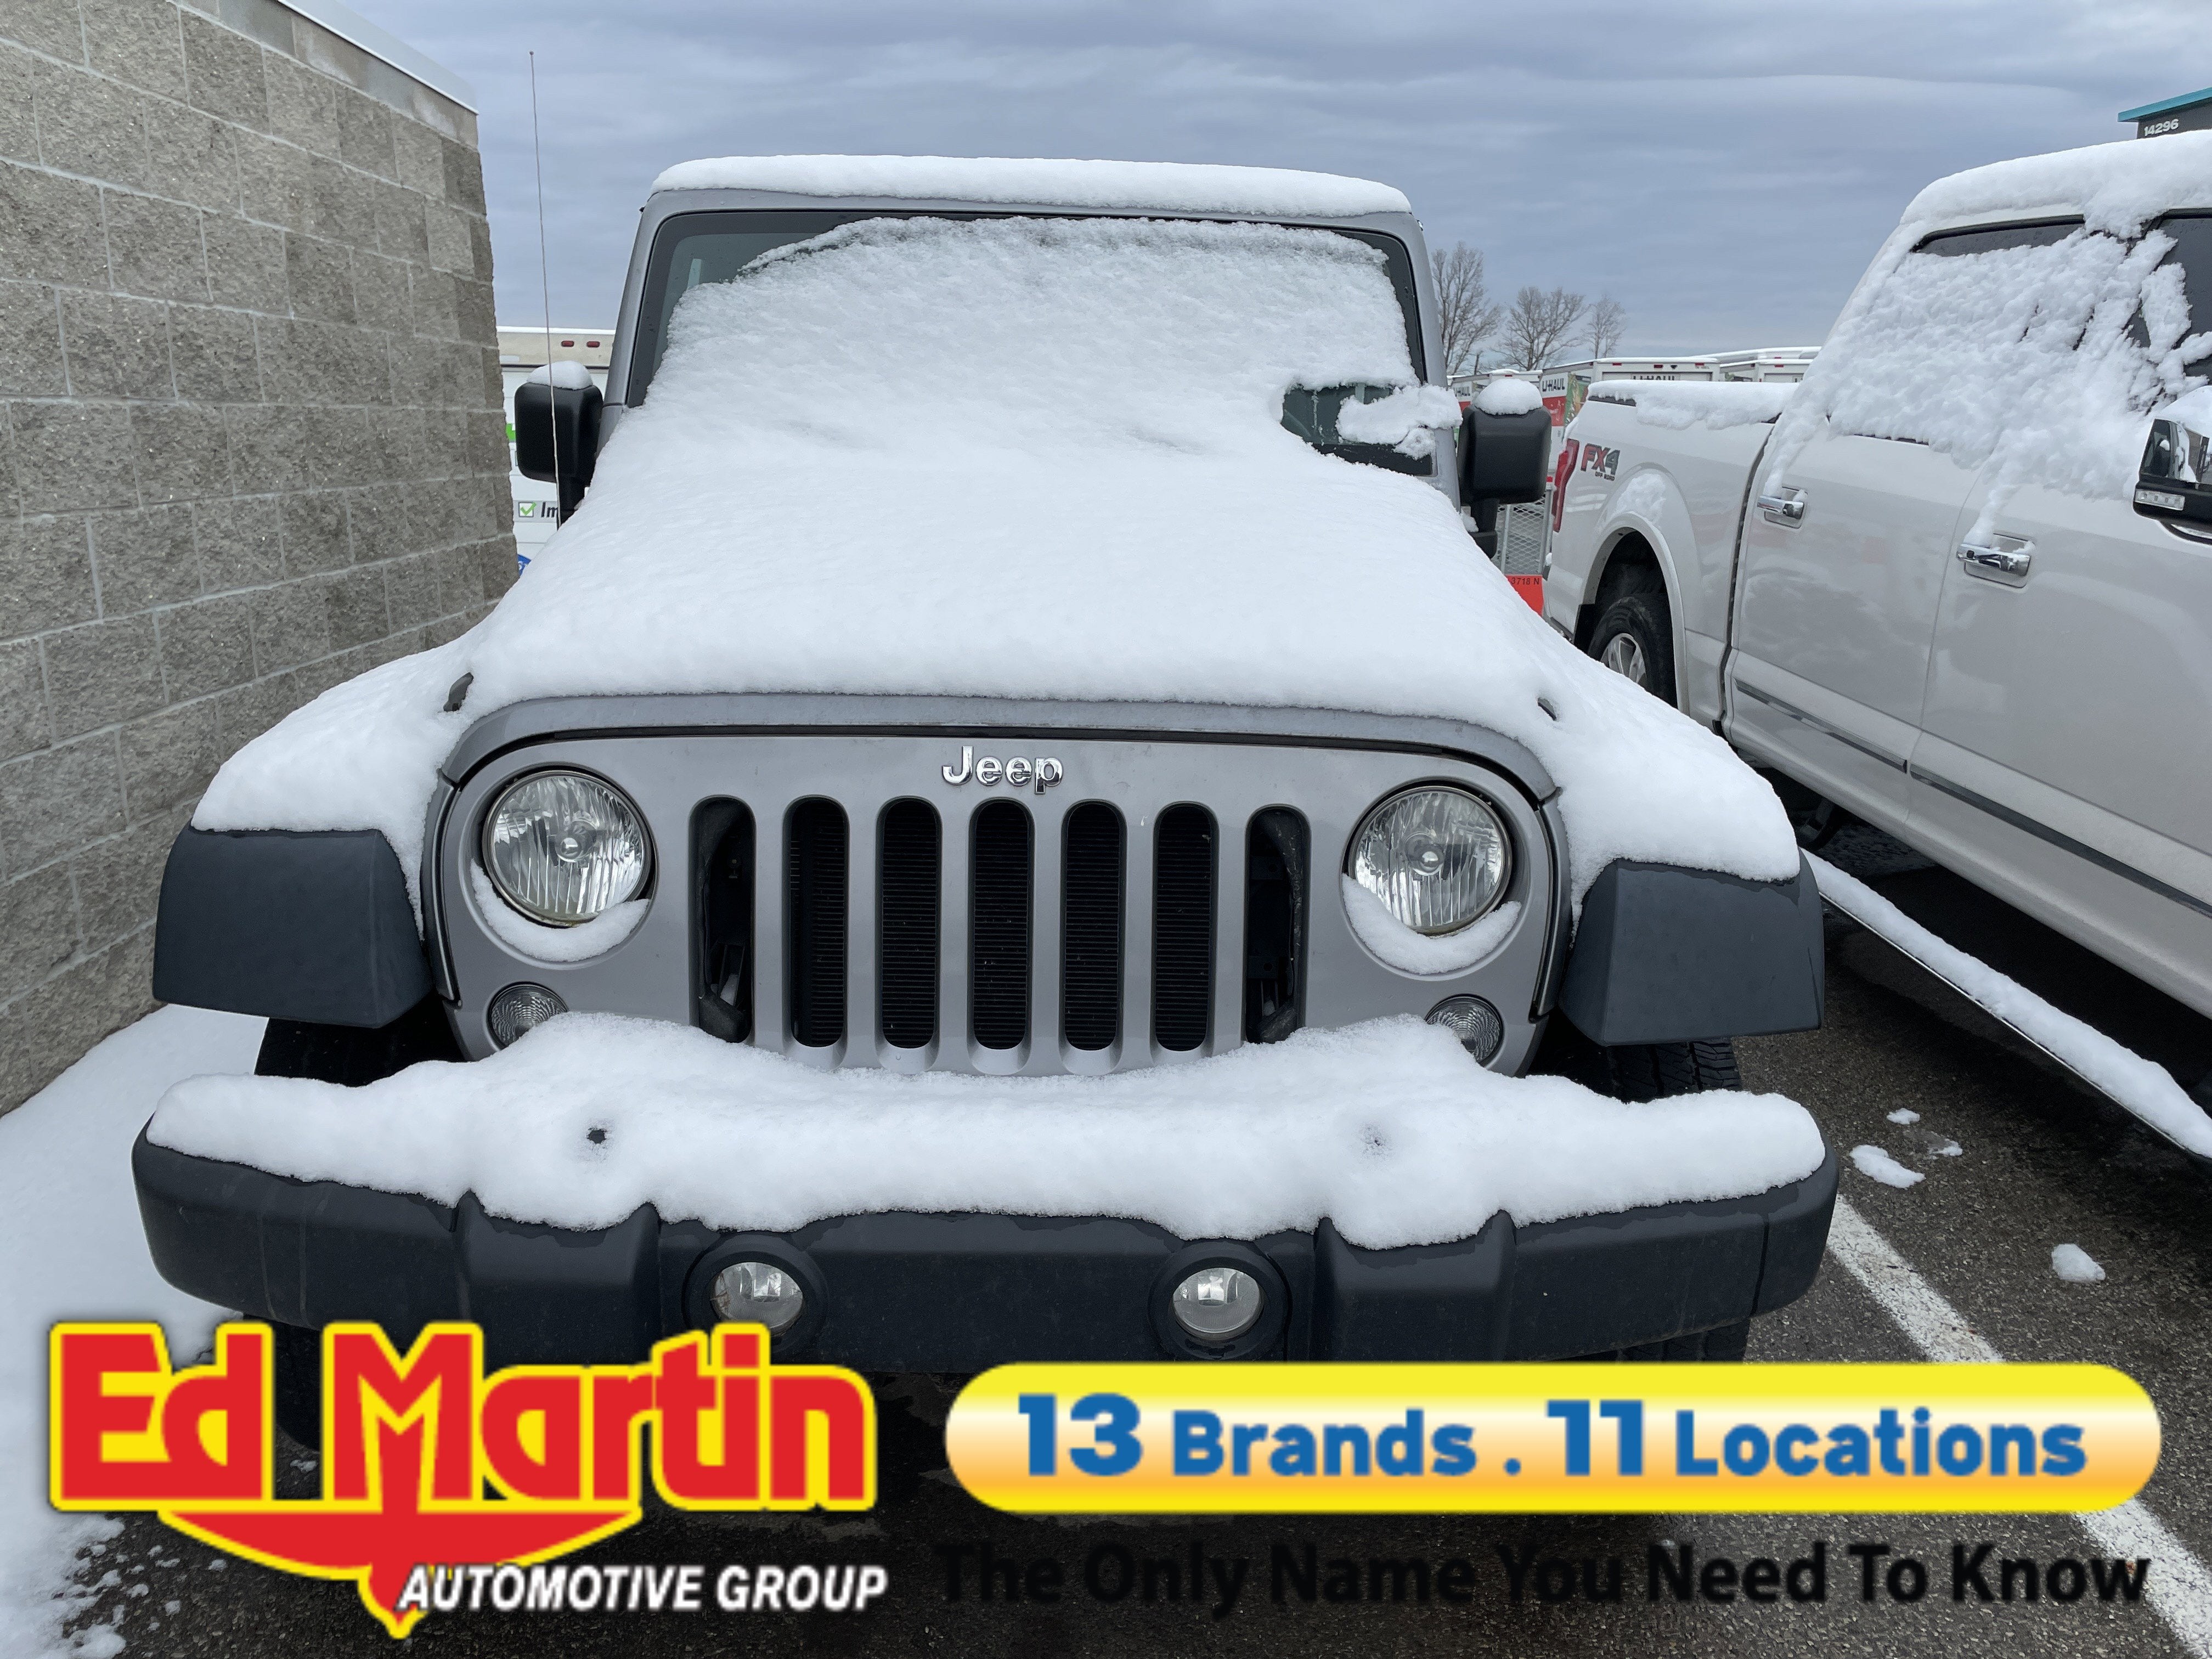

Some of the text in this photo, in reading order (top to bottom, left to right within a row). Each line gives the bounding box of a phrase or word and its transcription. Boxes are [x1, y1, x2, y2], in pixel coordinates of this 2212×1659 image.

[2143, 119, 2179, 137] 14296
[1581, 443, 1621, 476] FX4
[942, 746, 1063, 794] Jeep
